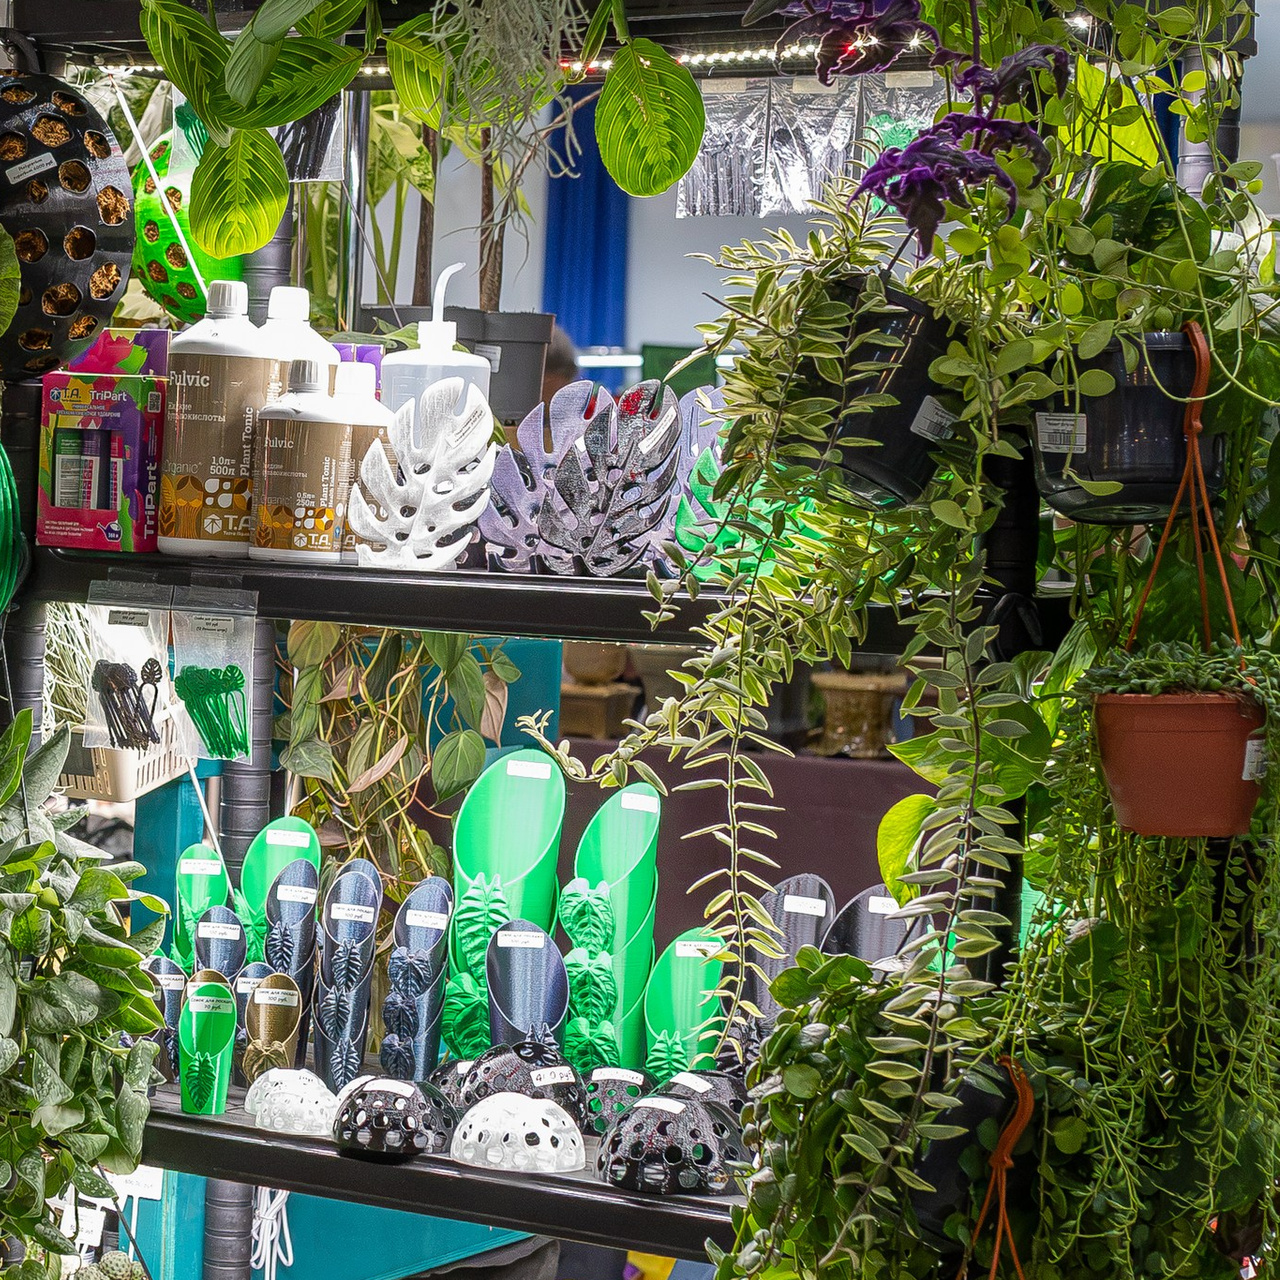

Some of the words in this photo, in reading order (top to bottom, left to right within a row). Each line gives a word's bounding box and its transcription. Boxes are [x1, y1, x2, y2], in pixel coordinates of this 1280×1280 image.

[169, 370, 210, 387] Fulvic
[61, 387, 82, 399] T.A.
[90, 390, 128, 402] TriPart
[242, 406, 255, 442] Tonic
[240, 443, 252, 477] Plant
[321, 456, 331, 480] Tonic
[144, 461, 158, 540] TriPart
[320, 483, 329, 508] Plant
